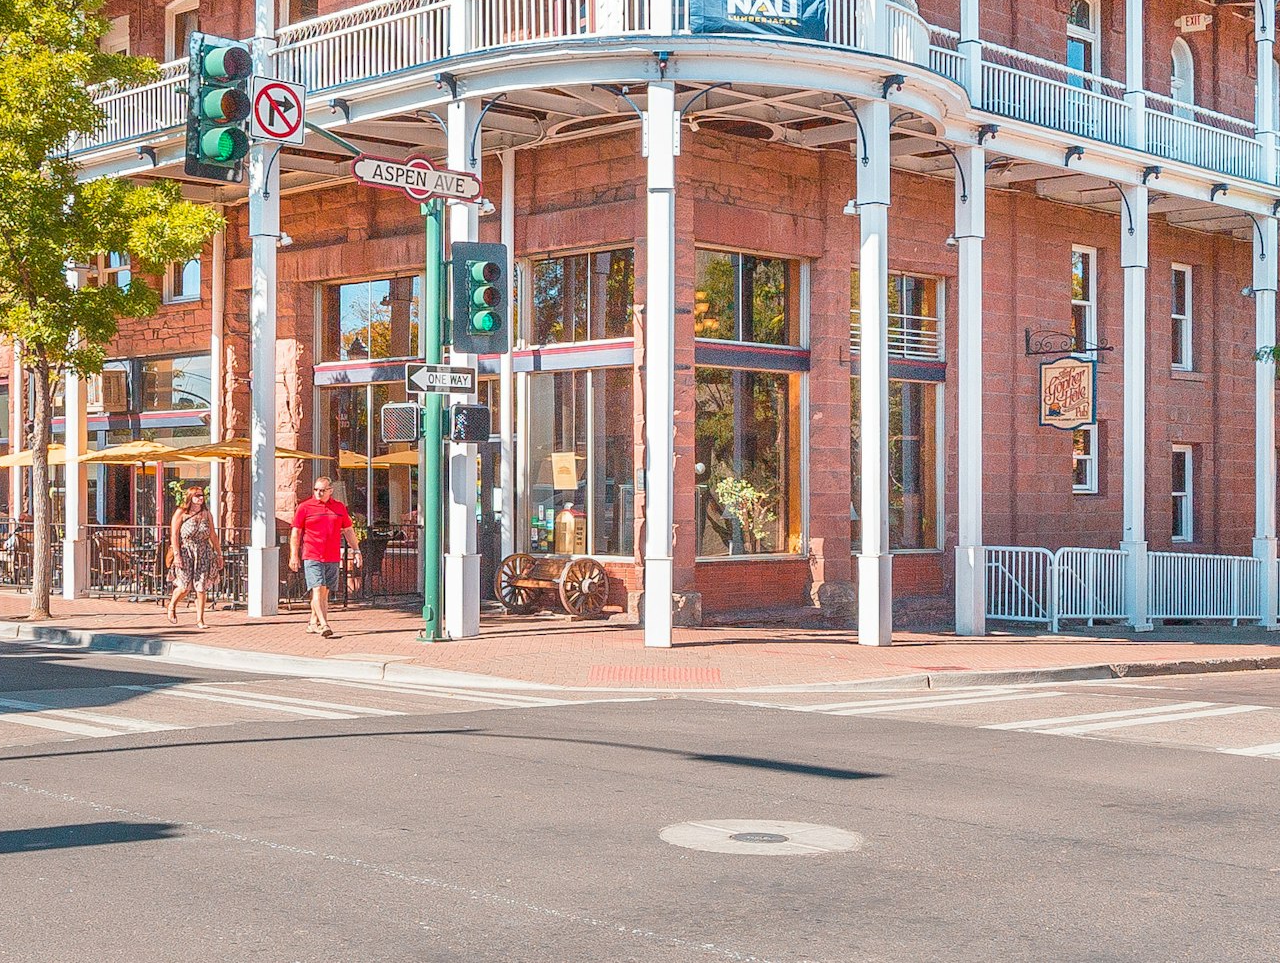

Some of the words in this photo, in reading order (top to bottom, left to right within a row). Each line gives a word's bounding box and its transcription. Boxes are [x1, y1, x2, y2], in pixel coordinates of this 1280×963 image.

[727, 15, 798, 26] LUMBERJACKS
[1185, 15, 1201, 27] EXIT
[372, 164, 427, 188] ASPEN
[433, 176, 465, 194] AVE
[428, 373, 447, 385] ONE
[449, 374, 469, 386] WAY
[1044, 367, 1086, 405] Gopher
[1062, 383, 1086, 408] Hole
[1075, 405, 1089, 417] Pub
